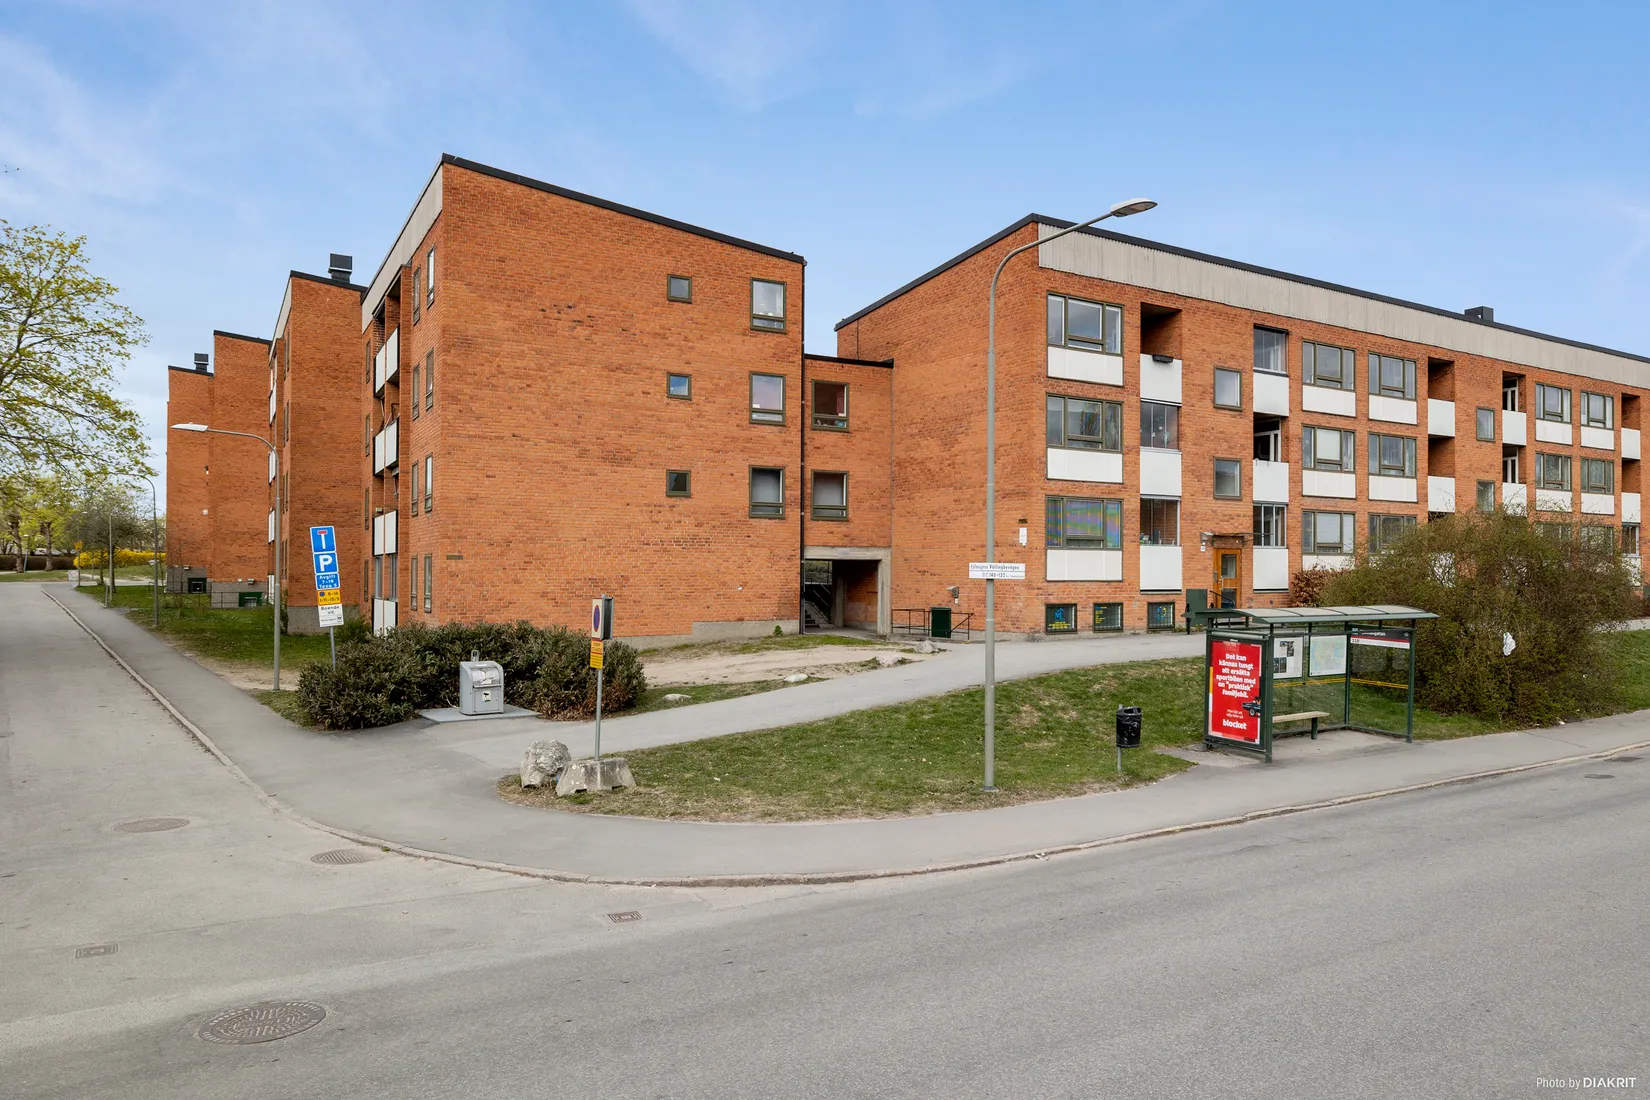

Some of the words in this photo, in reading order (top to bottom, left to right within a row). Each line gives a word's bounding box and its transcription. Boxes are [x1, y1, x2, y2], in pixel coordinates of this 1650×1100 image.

[319, 554, 332, 572] P
[1238, 662, 1253, 670] tungt
[1223, 719, 1247, 729] blocket
